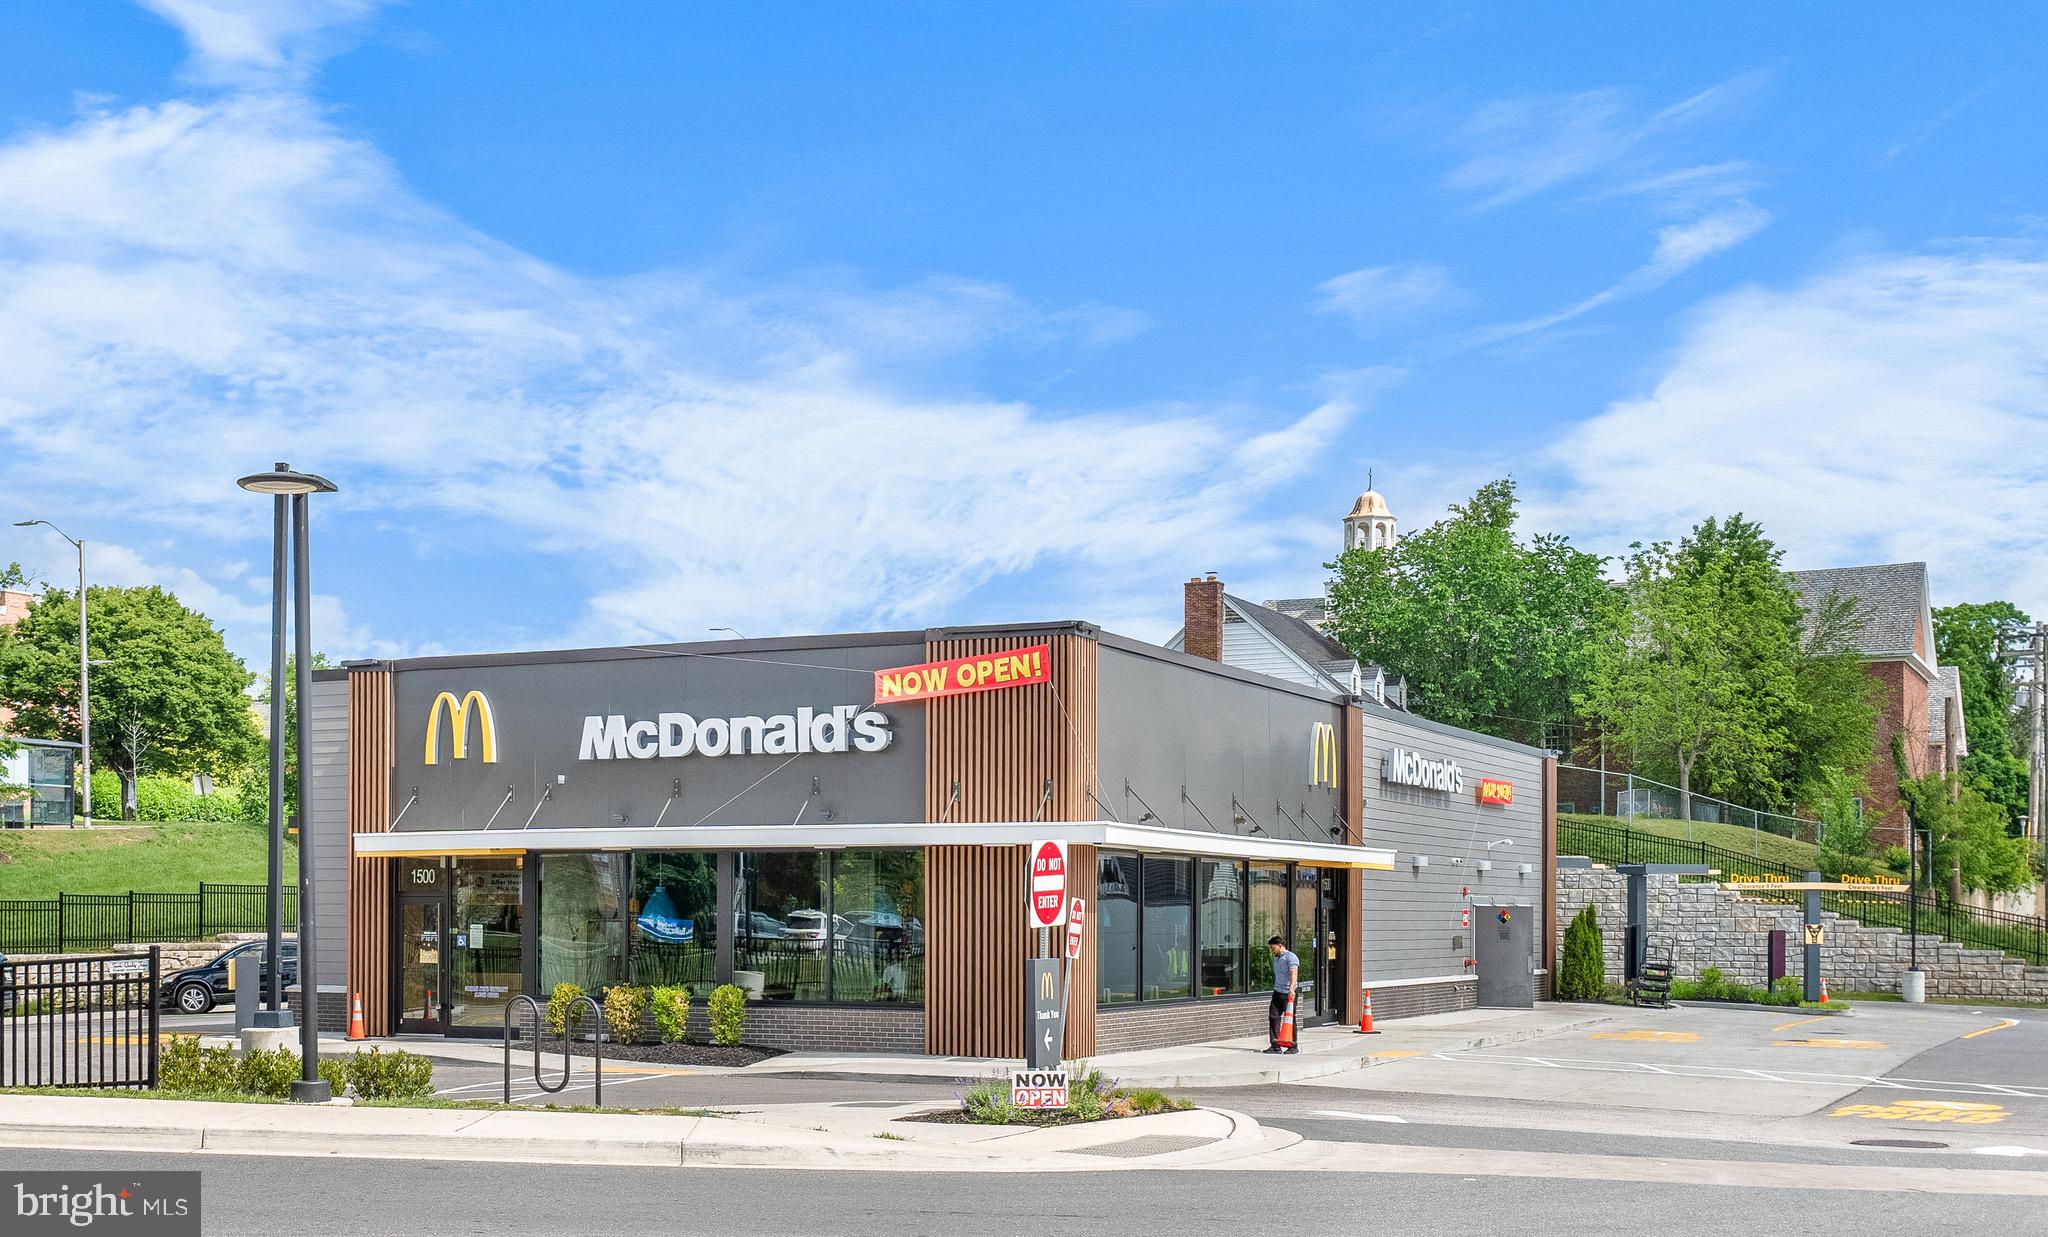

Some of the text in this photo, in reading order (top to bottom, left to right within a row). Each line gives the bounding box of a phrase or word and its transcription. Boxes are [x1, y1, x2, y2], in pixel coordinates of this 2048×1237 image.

[882, 652, 1042, 697] NOW OPEN!
[579, 705, 893, 760] McDonald's
[1390, 748, 1463, 794] McDonald's
[1037, 858, 1061, 872] DO NOT
[411, 868, 436, 884] 1500
[1730, 873, 1790, 884] Drive Thru
[1841, 873, 1901, 885] Drive Thru
[1038, 895, 1058, 909] ENTER
[1037, 1010, 1059, 1020] Thank You
[1016, 1074, 1066, 1088] NOW
[1016, 1089, 1065, 1106] OPEN
